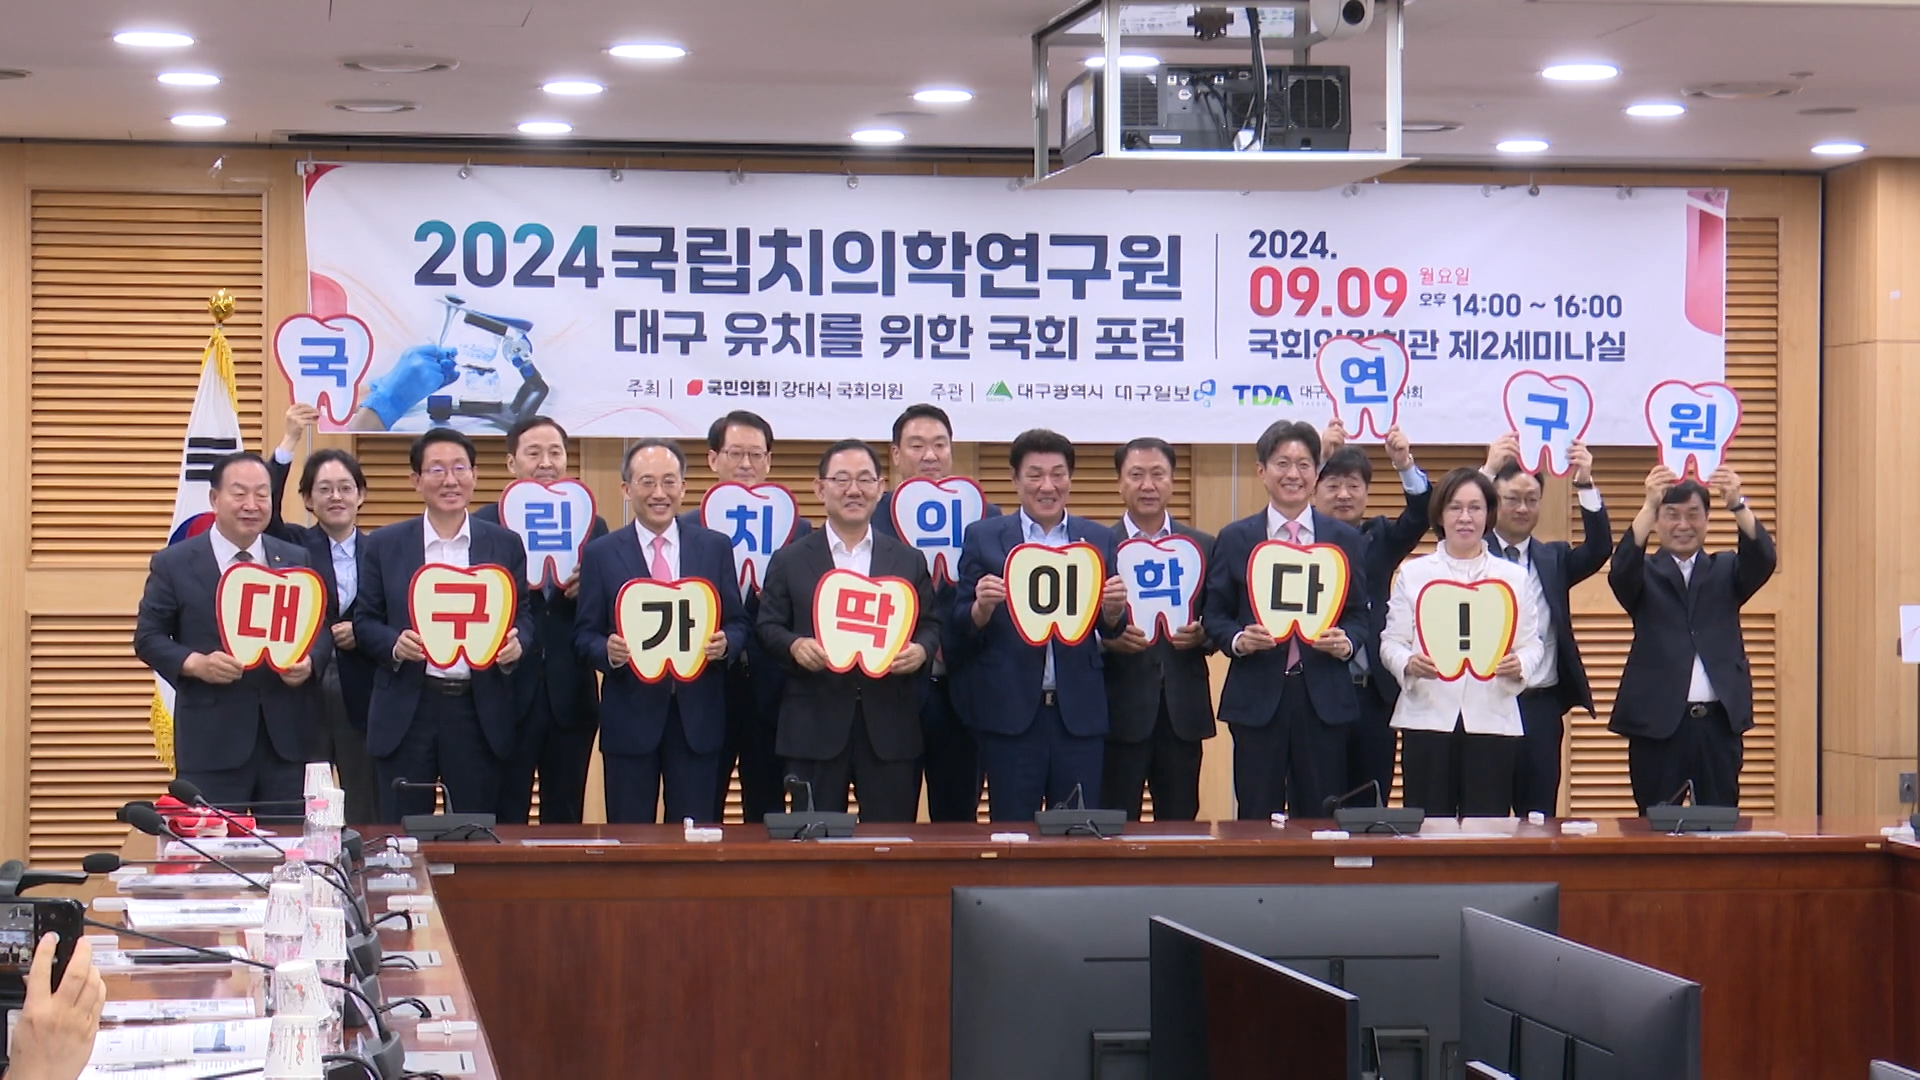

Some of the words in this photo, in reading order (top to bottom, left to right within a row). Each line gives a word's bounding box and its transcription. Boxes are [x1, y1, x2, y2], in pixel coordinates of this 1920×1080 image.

[1249, 230, 1338, 260] 2024.
[1250, 266, 1408, 318] 09.09
[1419, 267, 1470, 286] 월요일
[1419, 292, 1447, 307] 오후
[1453, 293, 1522, 318] 14:00
[1554, 294, 1623, 319] 16:00
[614, 309, 707, 354] 대구
[724, 312, 864, 358] 유치를
[880, 314, 973, 360] 위한
[988, 316, 1078, 360] 국회
[1095, 317, 1185, 362] 포럼
[1449, 329, 1626, 362] 제2세미나실
[298, 337, 349, 389] 국
[1340, 355, 1389, 405] 연
[627, 379, 660, 398] 주최
[707, 379, 771, 397] 국민의힘
[781, 381, 831, 400] 강대식
[836, 381, 904, 400] 국회의원
[931, 383, 964, 402] 주관
[1017, 383, 1103, 400] 대구광역시
[1115, 385, 1190, 402] 대구일보
[1232, 385, 1294, 406] TDA
[1524, 393, 1570, 442] 구
[1668, 402, 1717, 452] 원
[525, 501, 574, 553] 립
[725, 504, 775, 557] 치
[915, 499, 965, 551] 의
[1028, 565, 1077, 616] 이
[1133, 557, 1184, 607] 학
[1270, 563, 1324, 614] 다
[237, 582, 300, 642] 대
[431, 582, 490, 640] 구
[642, 599, 695, 652] 가
[836, 587, 896, 647] 딱
